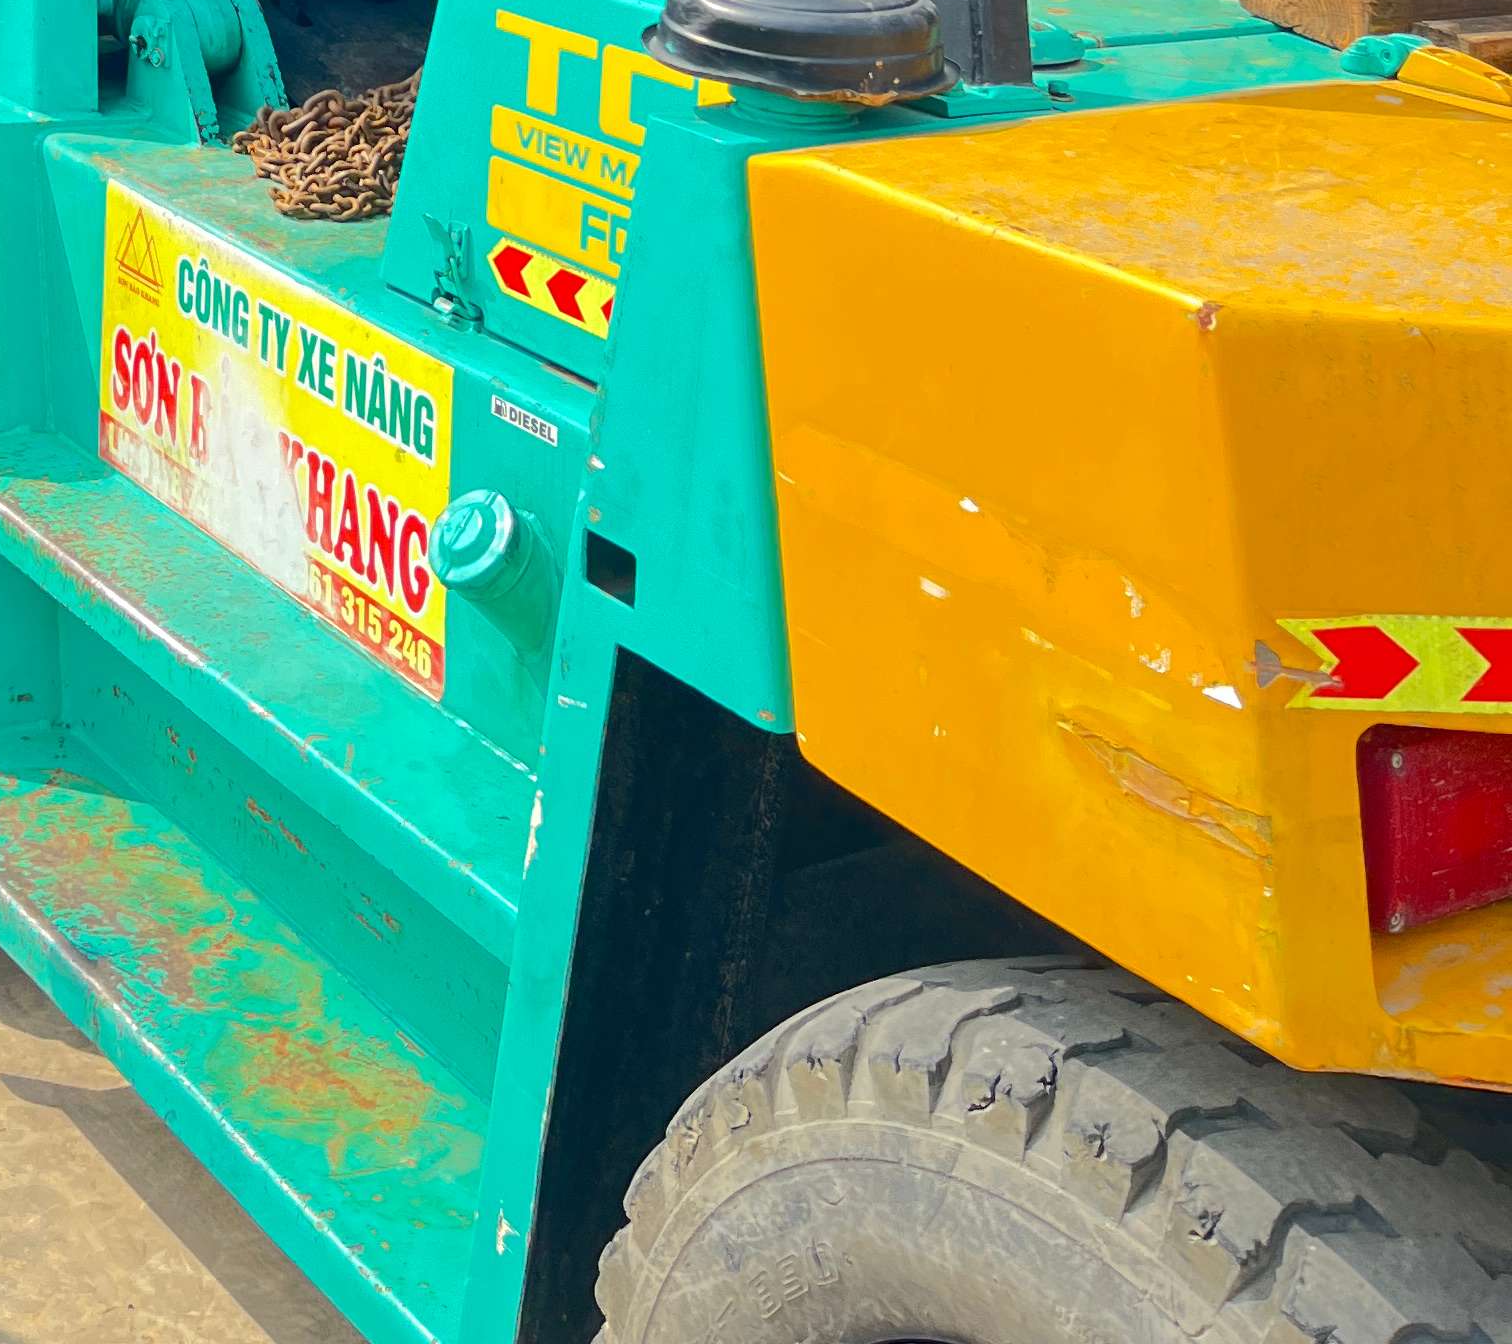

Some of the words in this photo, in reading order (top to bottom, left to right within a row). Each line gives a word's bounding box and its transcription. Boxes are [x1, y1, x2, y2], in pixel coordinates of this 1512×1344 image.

[496, 9, 737, 146] TC
[516, 121, 590, 171] VIEW
[600, 152, 636, 187] M
[112, 327, 181, 448] SƠN
[178, 258, 249, 349] CÔNG
[259, 302, 290, 372] TY
[297, 326, 336, 402] XE
[344, 349, 434, 461] NÂNG
[509, 406, 555, 443] DIESEL
[341, 585, 383, 645] 315
[384, 618, 432, 680] 246
